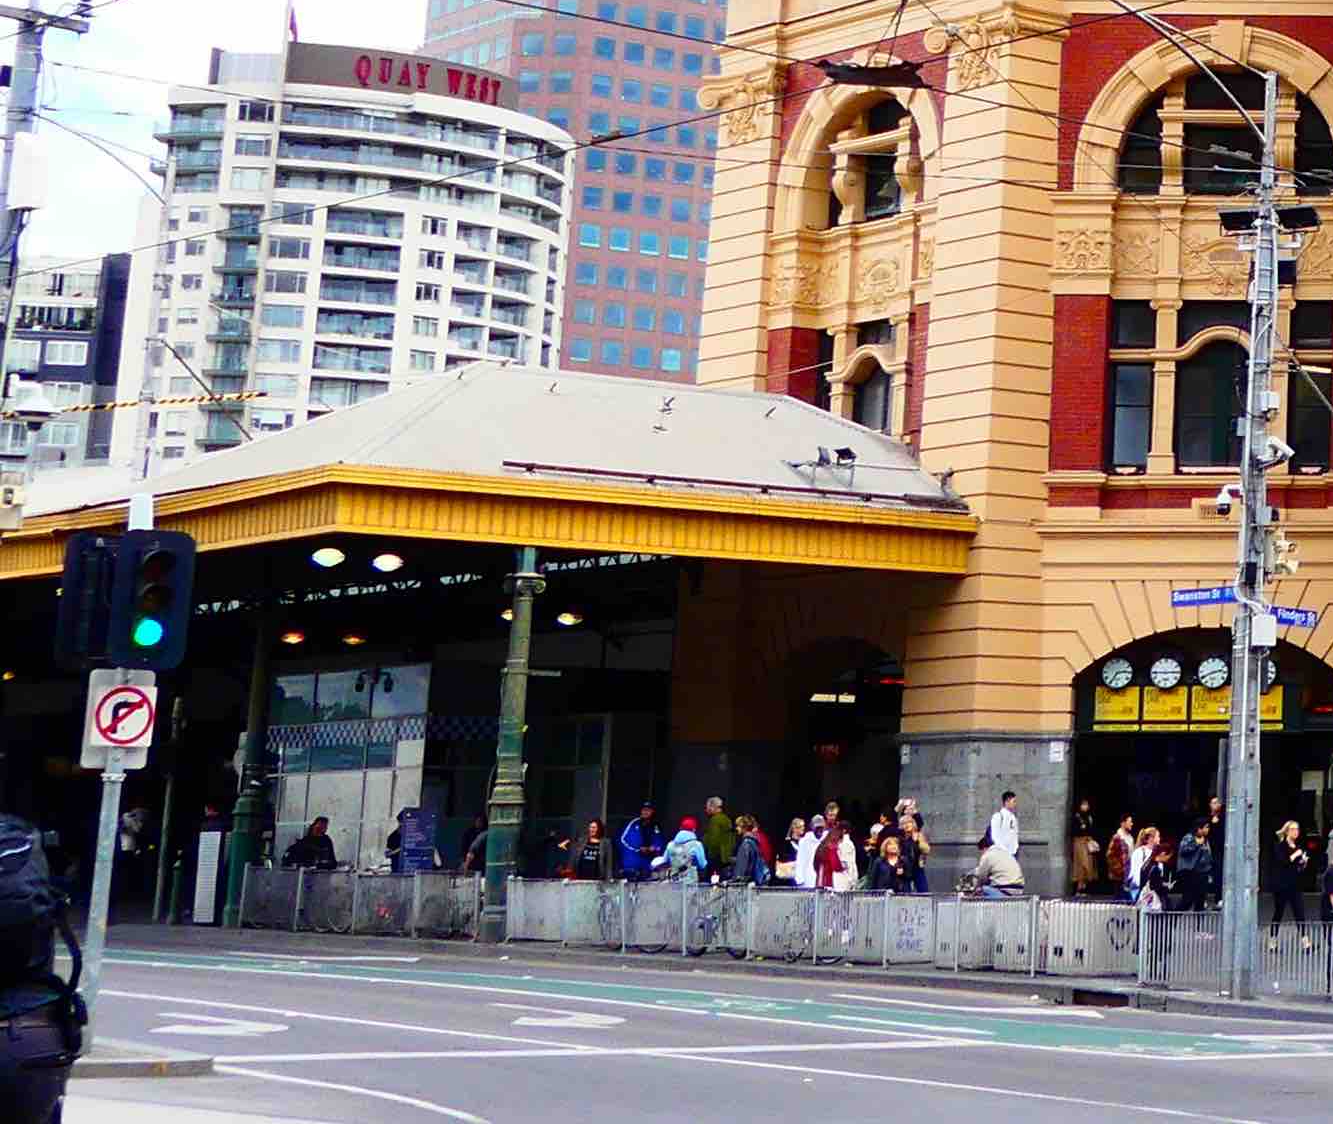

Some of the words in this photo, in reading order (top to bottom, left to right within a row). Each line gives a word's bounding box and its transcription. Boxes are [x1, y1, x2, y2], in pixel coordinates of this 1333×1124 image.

[355, 55, 431, 89] QUAY
[447, 68, 501, 105] WEST
[1173, 590, 1209, 602] Swanston
[1278, 609, 1306, 621] Flinders
